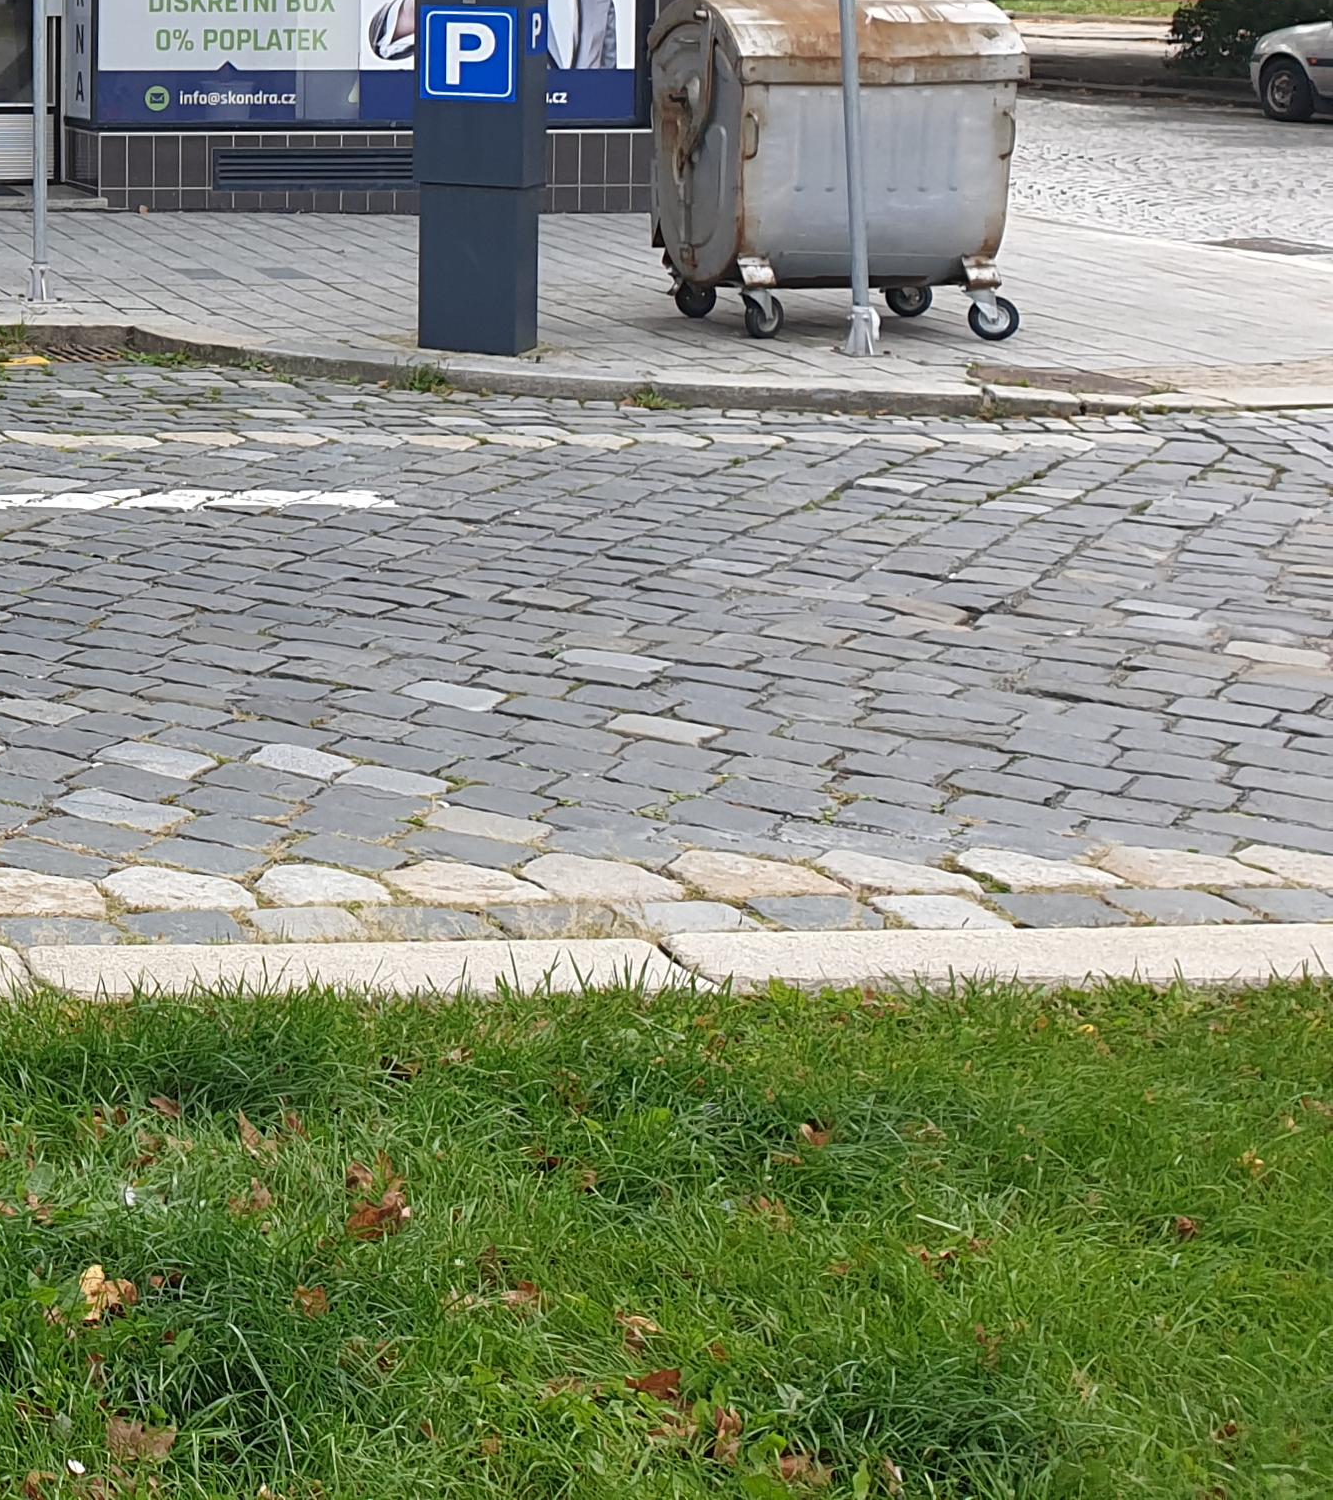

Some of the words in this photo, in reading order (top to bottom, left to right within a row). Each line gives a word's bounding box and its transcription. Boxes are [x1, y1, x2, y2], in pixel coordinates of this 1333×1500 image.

[155, 29, 194, 51] 0%
[203, 29, 328, 51] POPLATEK
[532, 12, 542, 49] P
[445, 22, 496, 85] P
[178, 89, 297, 106] info@skondra.cz
